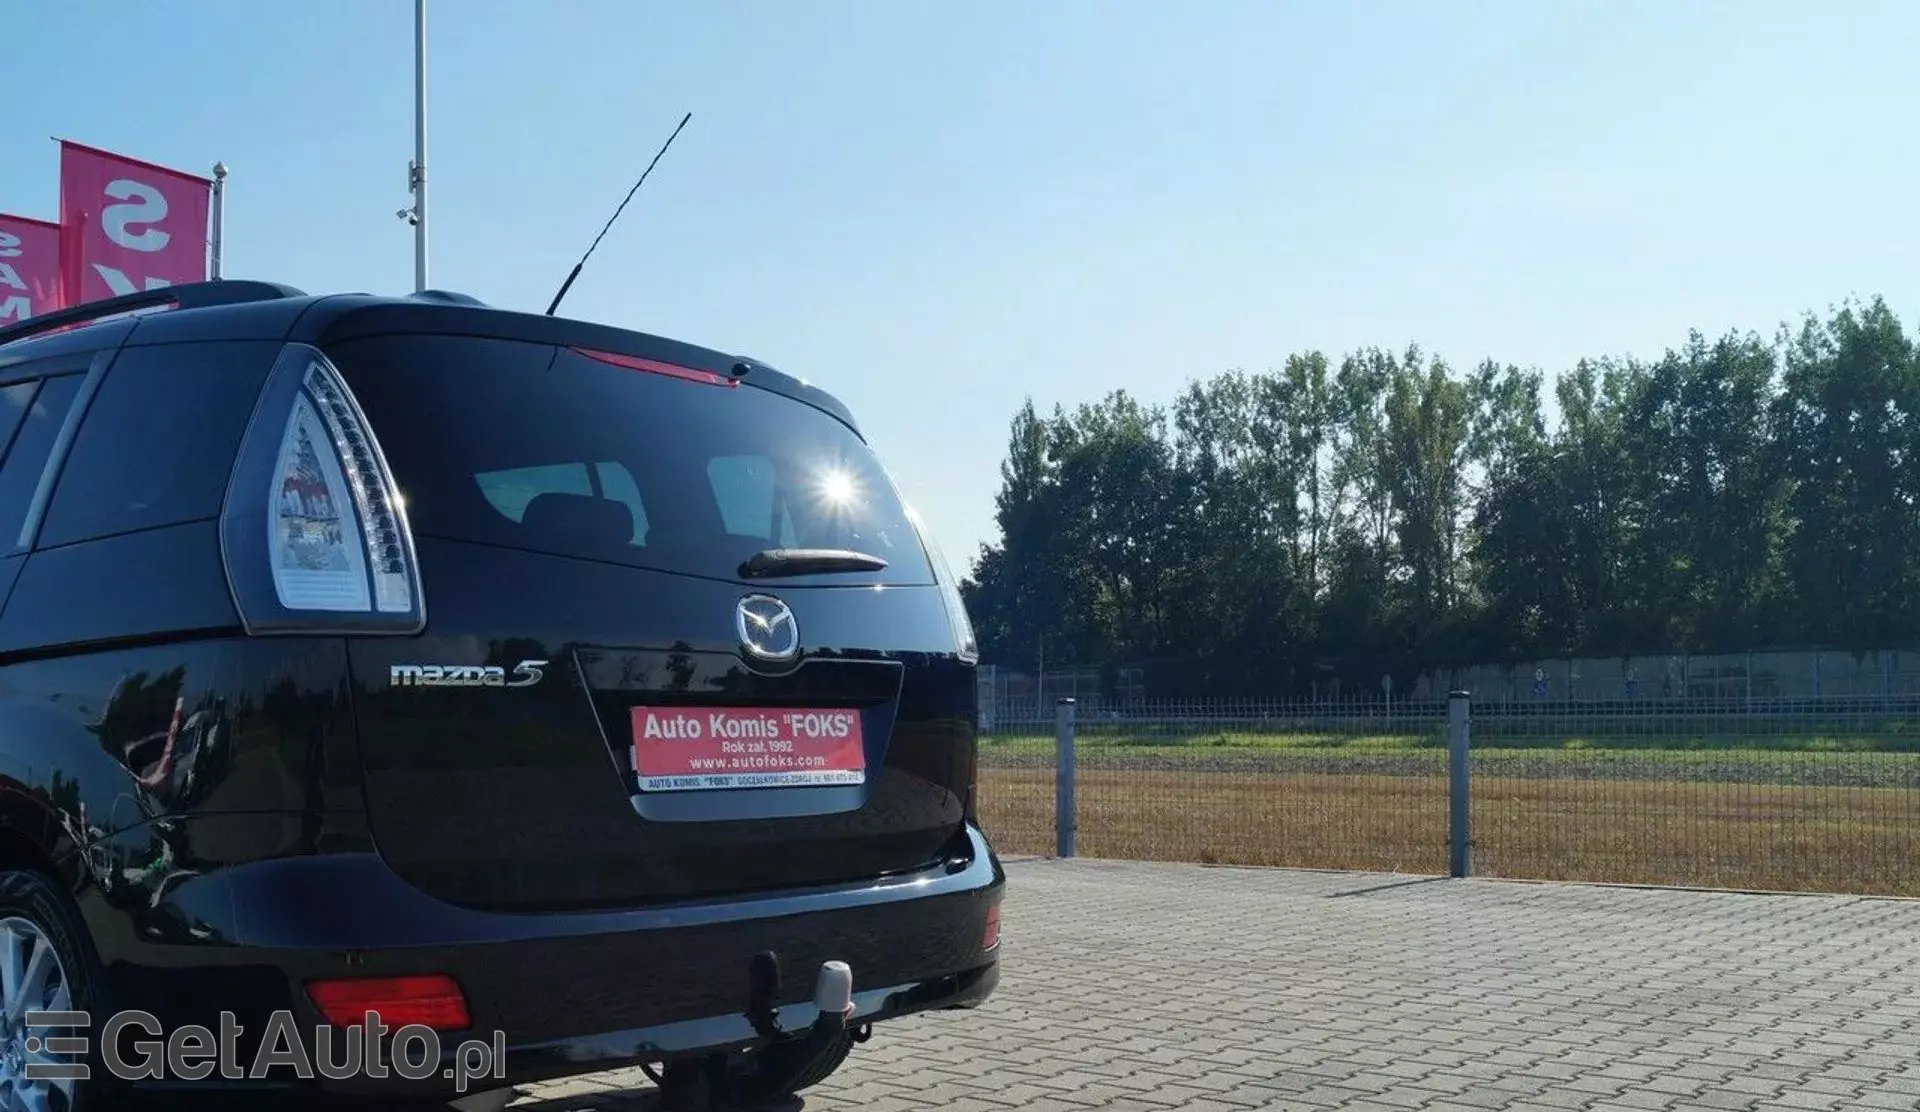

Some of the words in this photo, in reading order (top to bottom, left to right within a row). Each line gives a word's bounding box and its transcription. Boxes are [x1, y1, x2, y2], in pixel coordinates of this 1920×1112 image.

[506, 660, 549, 687] 5
[644, 713, 702, 739] Auto
[709, 714, 779, 739] Komis
[783, 713, 855, 739] "FOKS"
[722, 741, 746, 753] Rok
[769, 740, 794, 753] 1992
[690, 755, 826, 770] www.autofoks.com
[648, 778, 672, 789] AUTO
